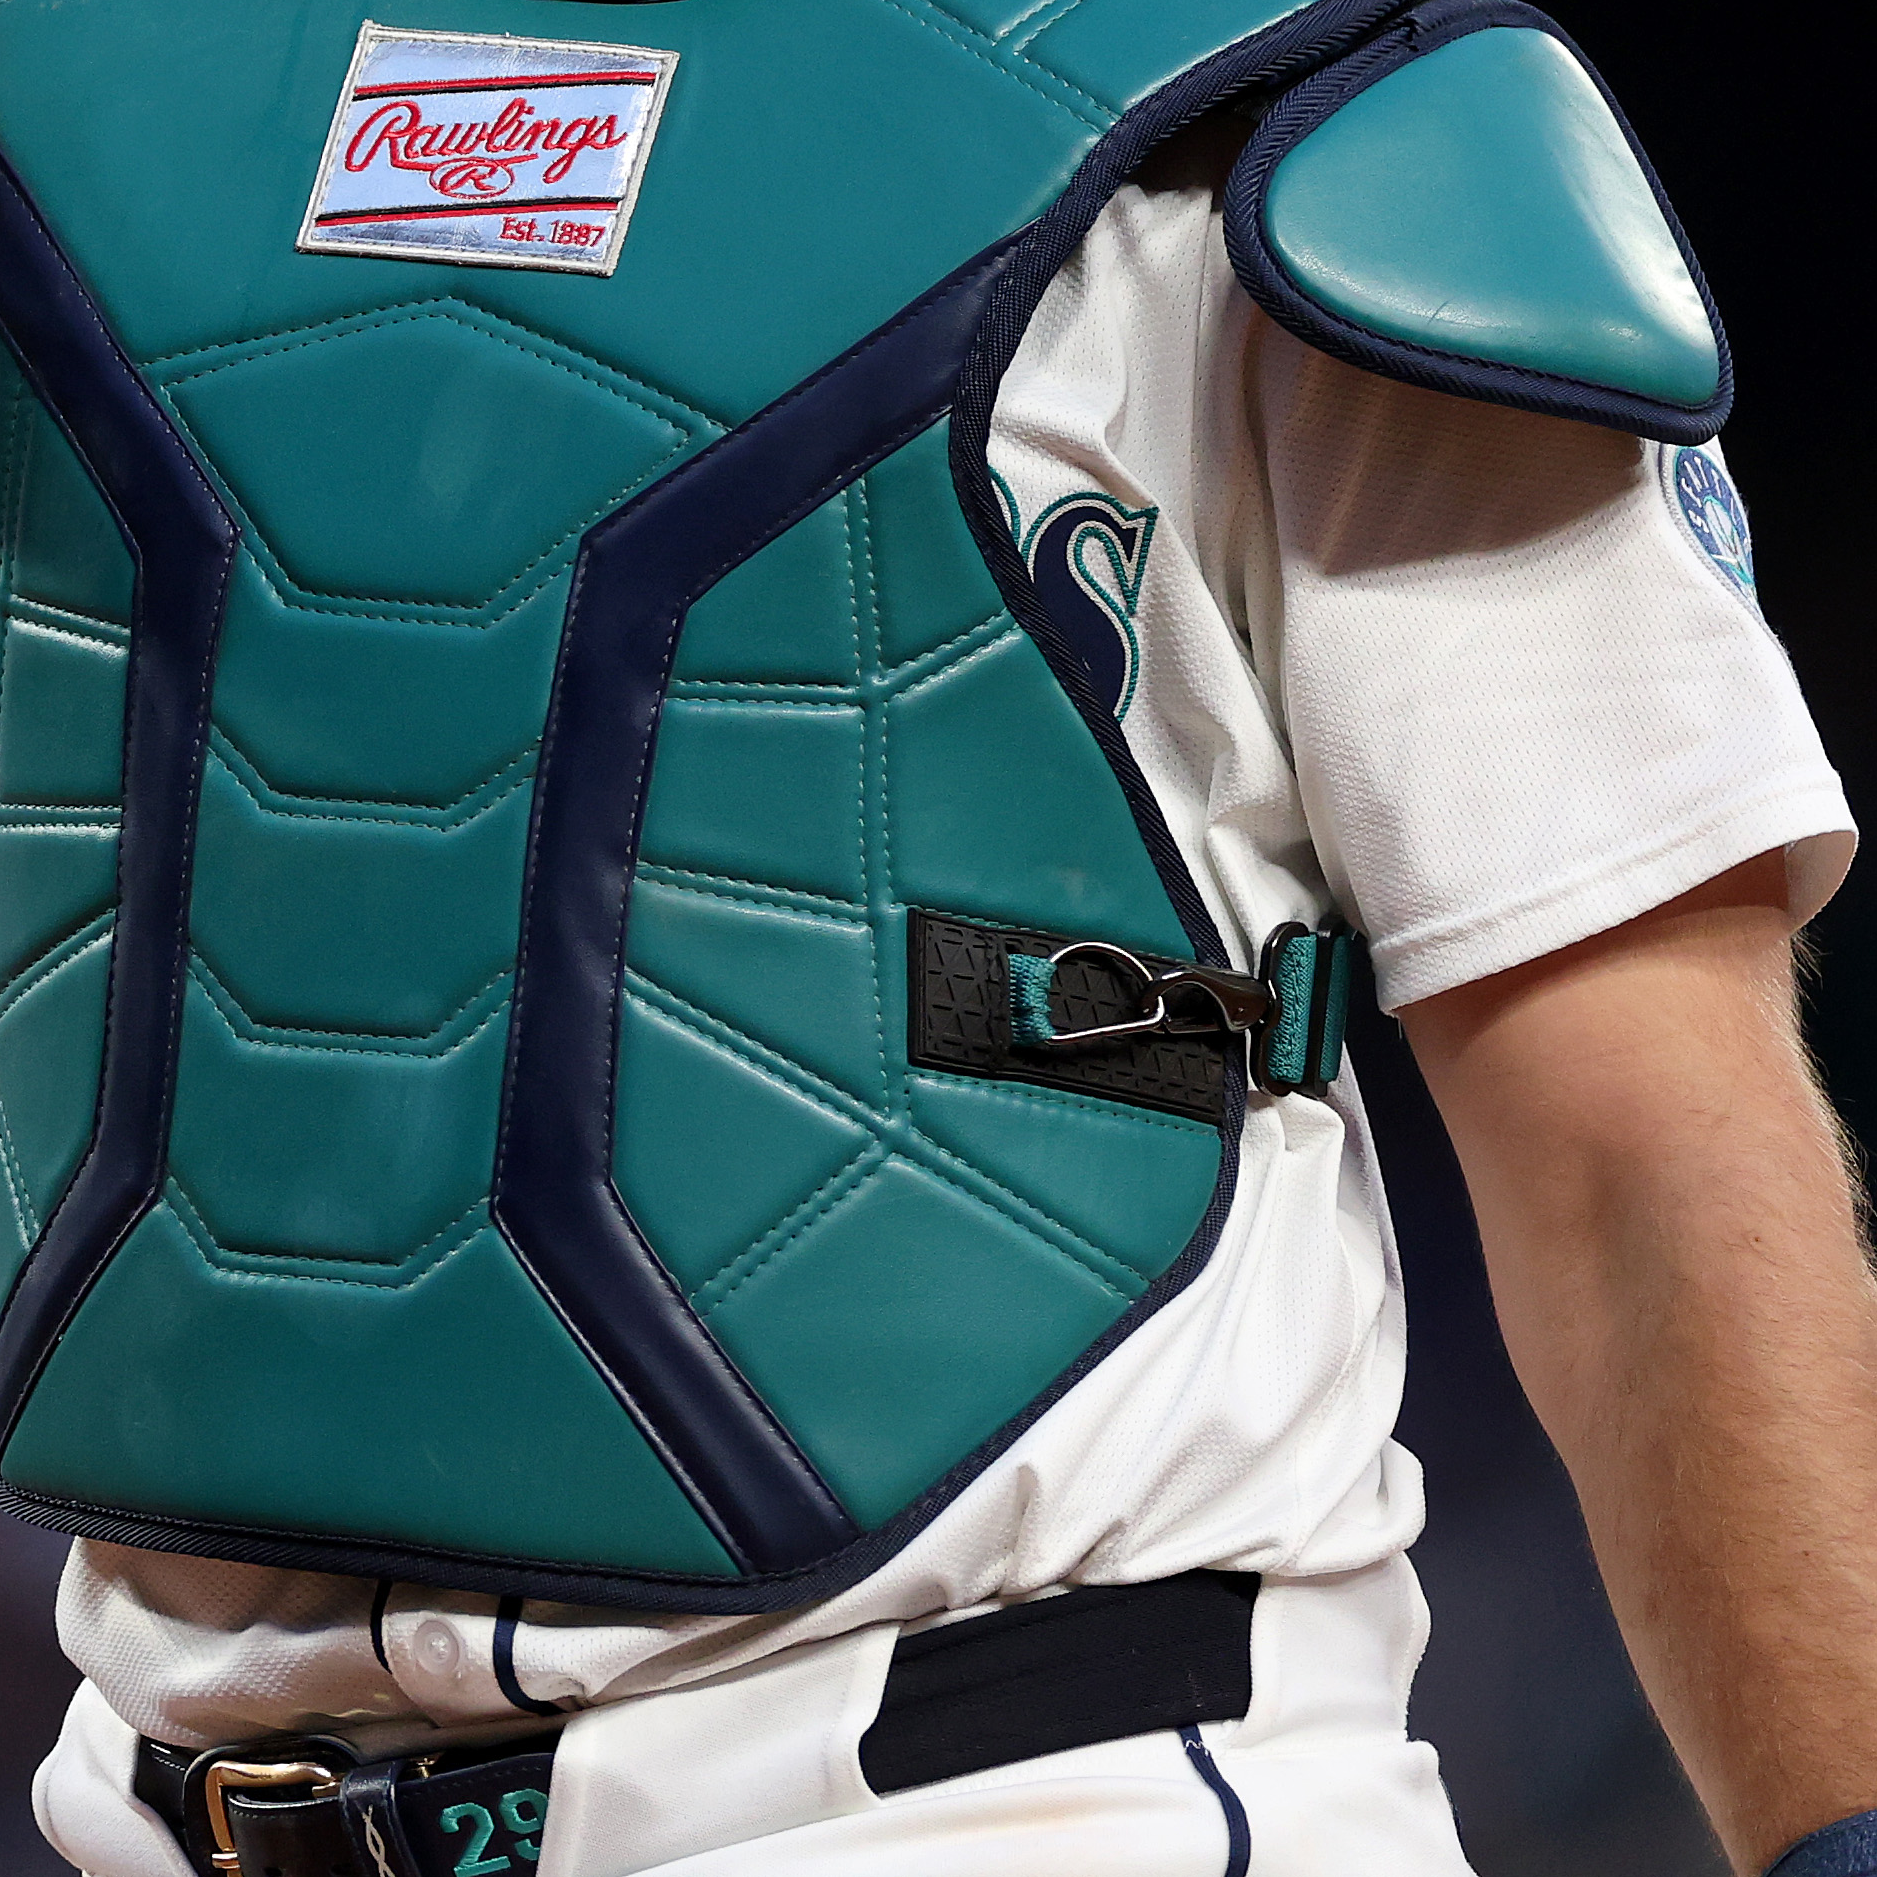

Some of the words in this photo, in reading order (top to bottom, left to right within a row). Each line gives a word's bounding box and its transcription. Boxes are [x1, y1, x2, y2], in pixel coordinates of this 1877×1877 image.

[344, 97, 628, 184] Rawlings
[499, 216, 545, 242] Est.
[548, 219, 605, 247] 1887
[439, 1788, 549, 1877] 29
